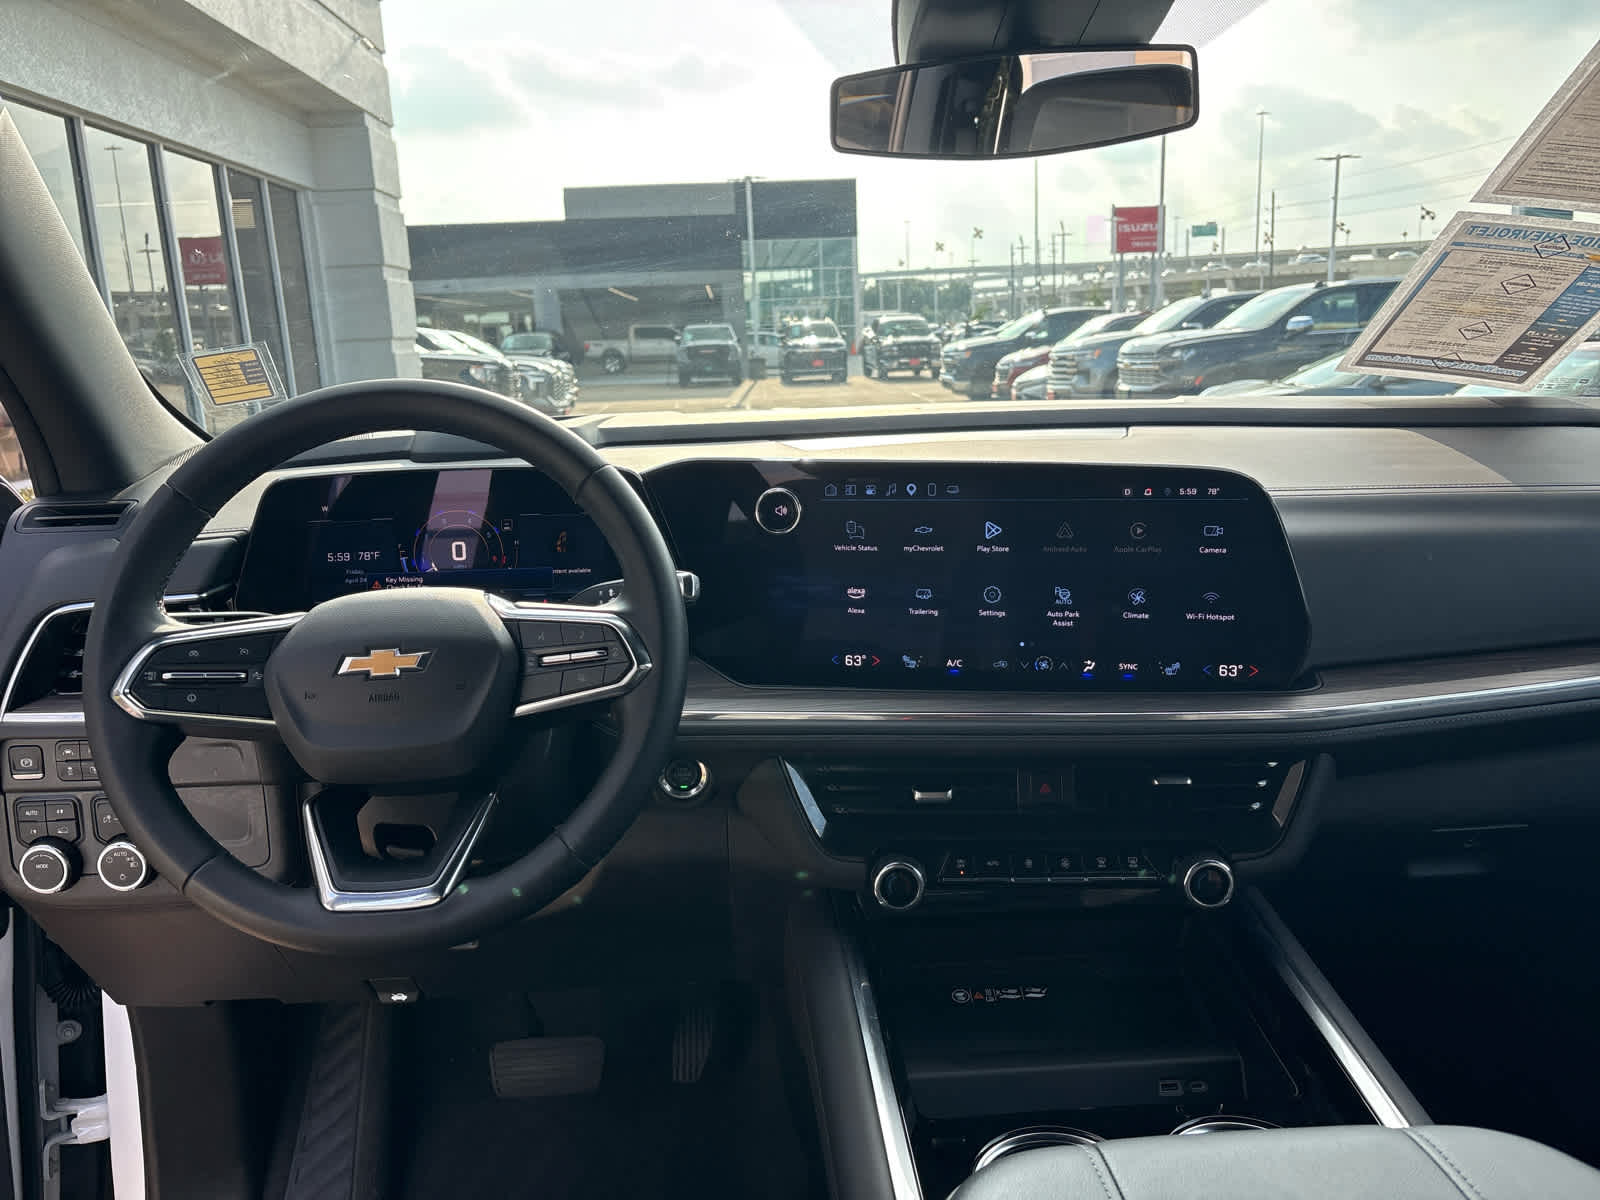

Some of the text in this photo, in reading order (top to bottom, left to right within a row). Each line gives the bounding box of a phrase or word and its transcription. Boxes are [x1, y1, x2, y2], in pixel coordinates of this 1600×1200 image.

[1179, 488, 1197, 496] 5:59
[451, 541, 467, 561] 0
[834, 544, 856, 552] Vehicle
[903, 545, 944, 553] myChevrolet
[976, 545, 1010, 554] Play Store
[1199, 546, 1227, 554] Camera
[327, 551, 380, 562] 5:59 78°F
[385, 576, 424, 585] Key Missing
[847, 587, 866, 595] alexa
[848, 607, 865, 615] Alexa
[909, 608, 938, 617] Trailering
[978, 609, 1006, 618] Settings
[1122, 612, 1150, 620] Climate
[1185, 612, 1235, 622] Wi-Fi Hotspot
[1052, 619, 1073, 627] Assist
[946, 658, 963, 668] A/C
[1118, 663, 1138, 671] SYNC
